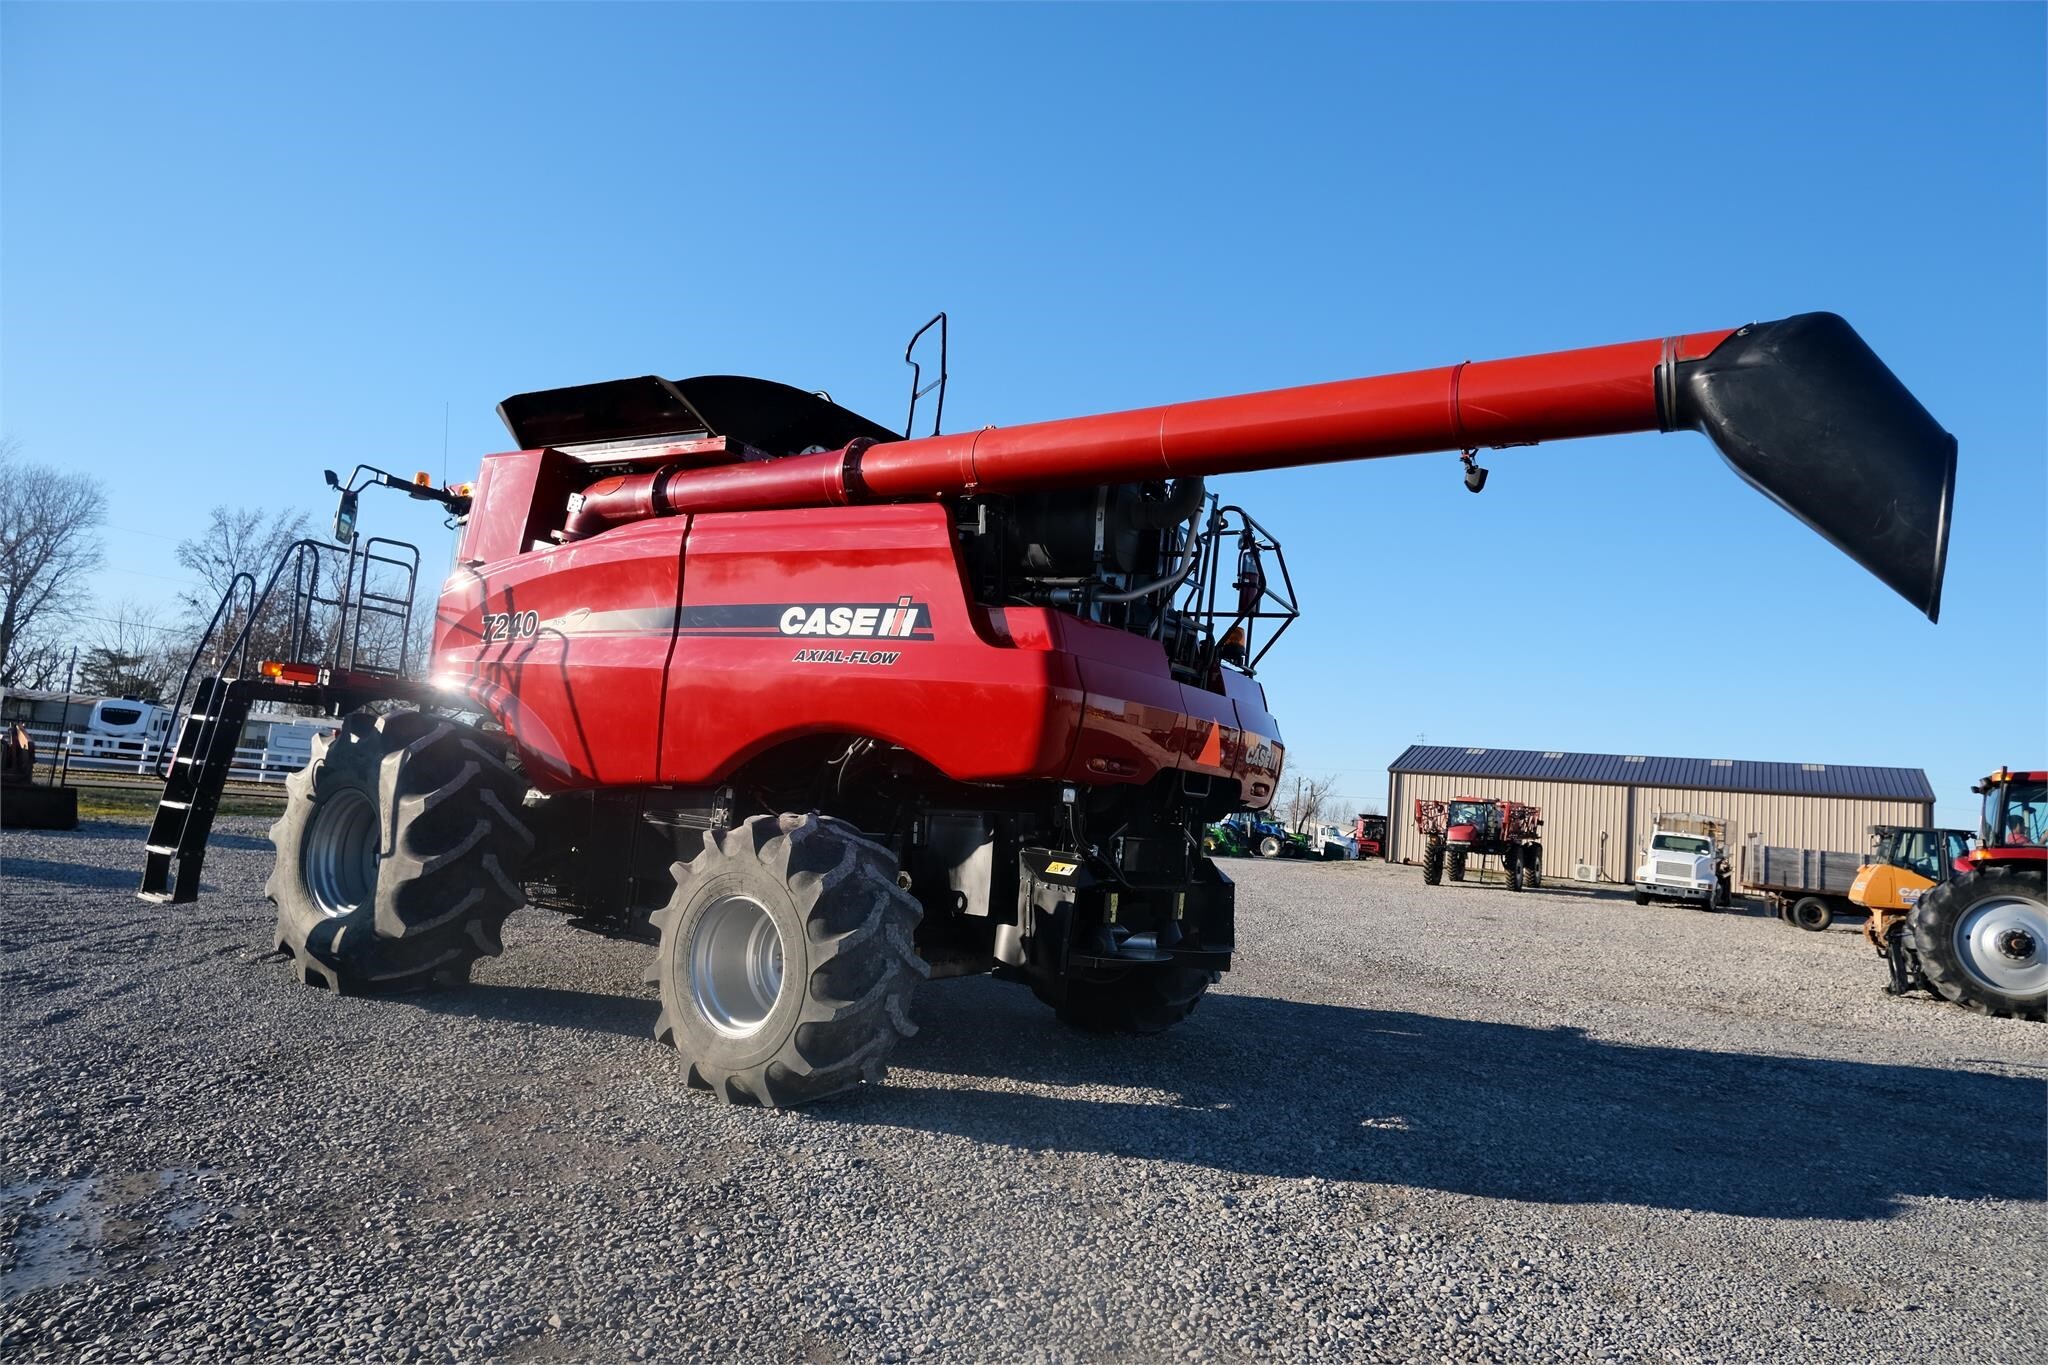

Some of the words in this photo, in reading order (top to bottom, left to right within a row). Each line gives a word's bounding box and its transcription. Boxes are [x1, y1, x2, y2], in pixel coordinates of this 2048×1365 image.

[481, 610, 539, 642] 7240
[780, 606, 880, 636] CASE
[792, 649, 902, 666] AXIAL-FLOW
[1245, 747, 1272, 768] CASE
